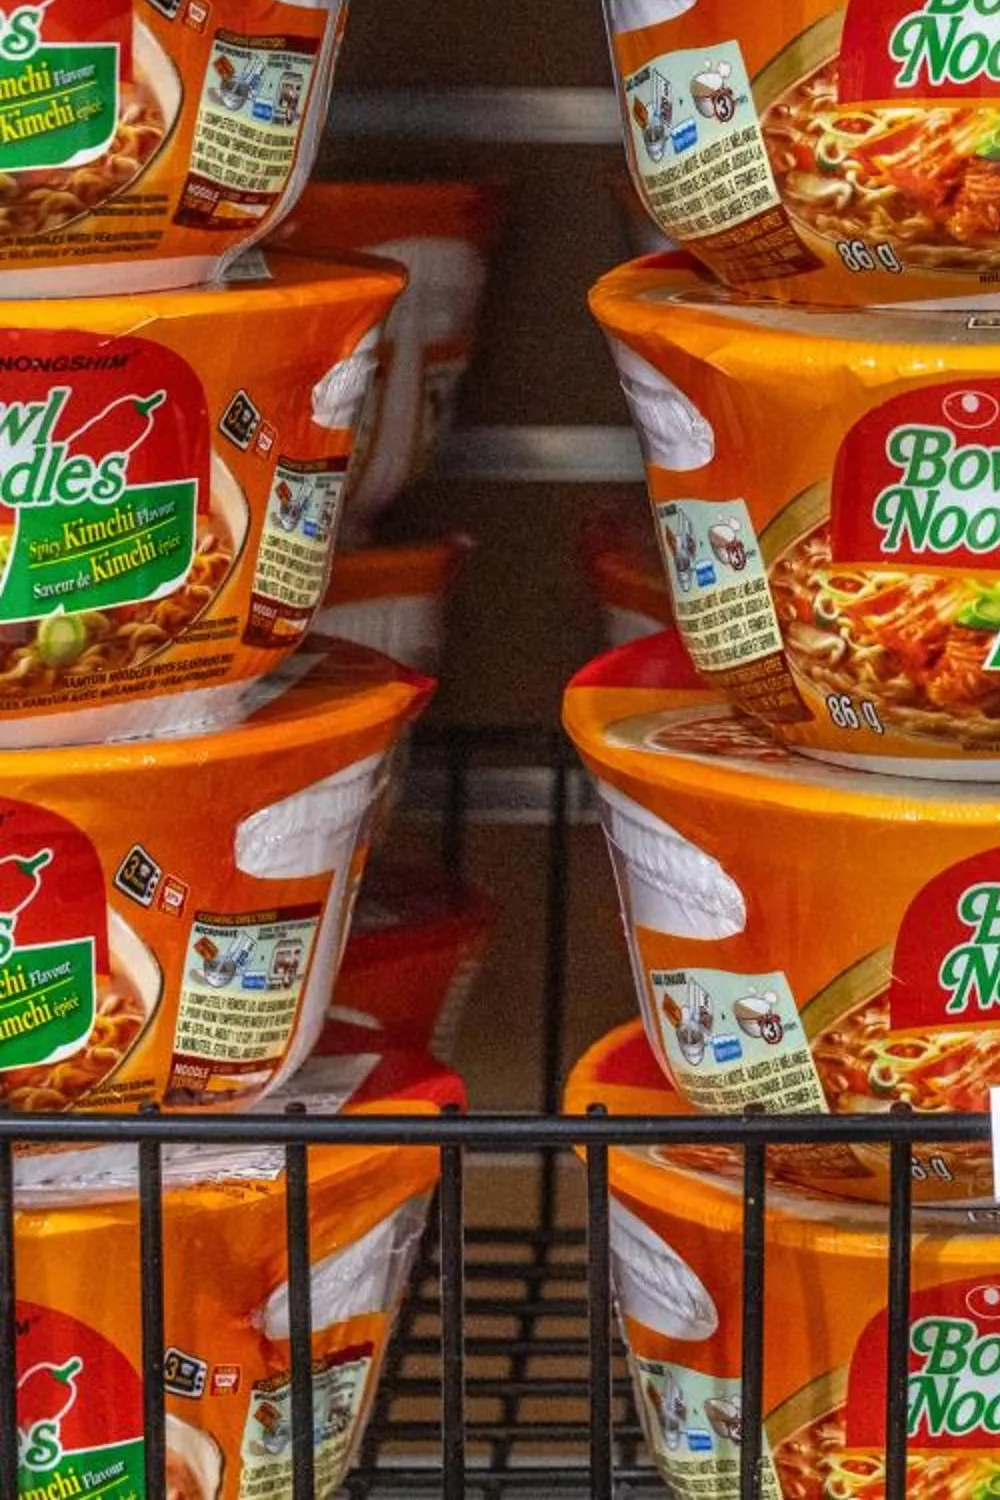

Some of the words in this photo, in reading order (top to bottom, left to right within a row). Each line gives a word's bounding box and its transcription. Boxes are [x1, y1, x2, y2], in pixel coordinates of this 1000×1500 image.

[53, 65, 95, 87] Flavour
[0, 96, 74, 142] Kimchi
[839, 241, 868, 271] 86
[877, 241, 900, 270] g
[0, 355, 128, 372] NONGSHIM
[1, 443, 128, 504] dles
[29, 540, 62, 559] Spicy
[63, 504, 136, 550] Kimchi
[137, 501, 175, 527] Flavour
[33, 575, 74, 599] Saveur
[76, 571, 90, 587] de
[90, 535, 157, 583] Kimchi
[827, 696, 860, 730] 86
[861, 701, 883, 735] g
[29, 960, 73, 988] Flavour
[173, 1063, 210, 1079] NOODLE
[82, 1460, 125, 1488] Flavour
